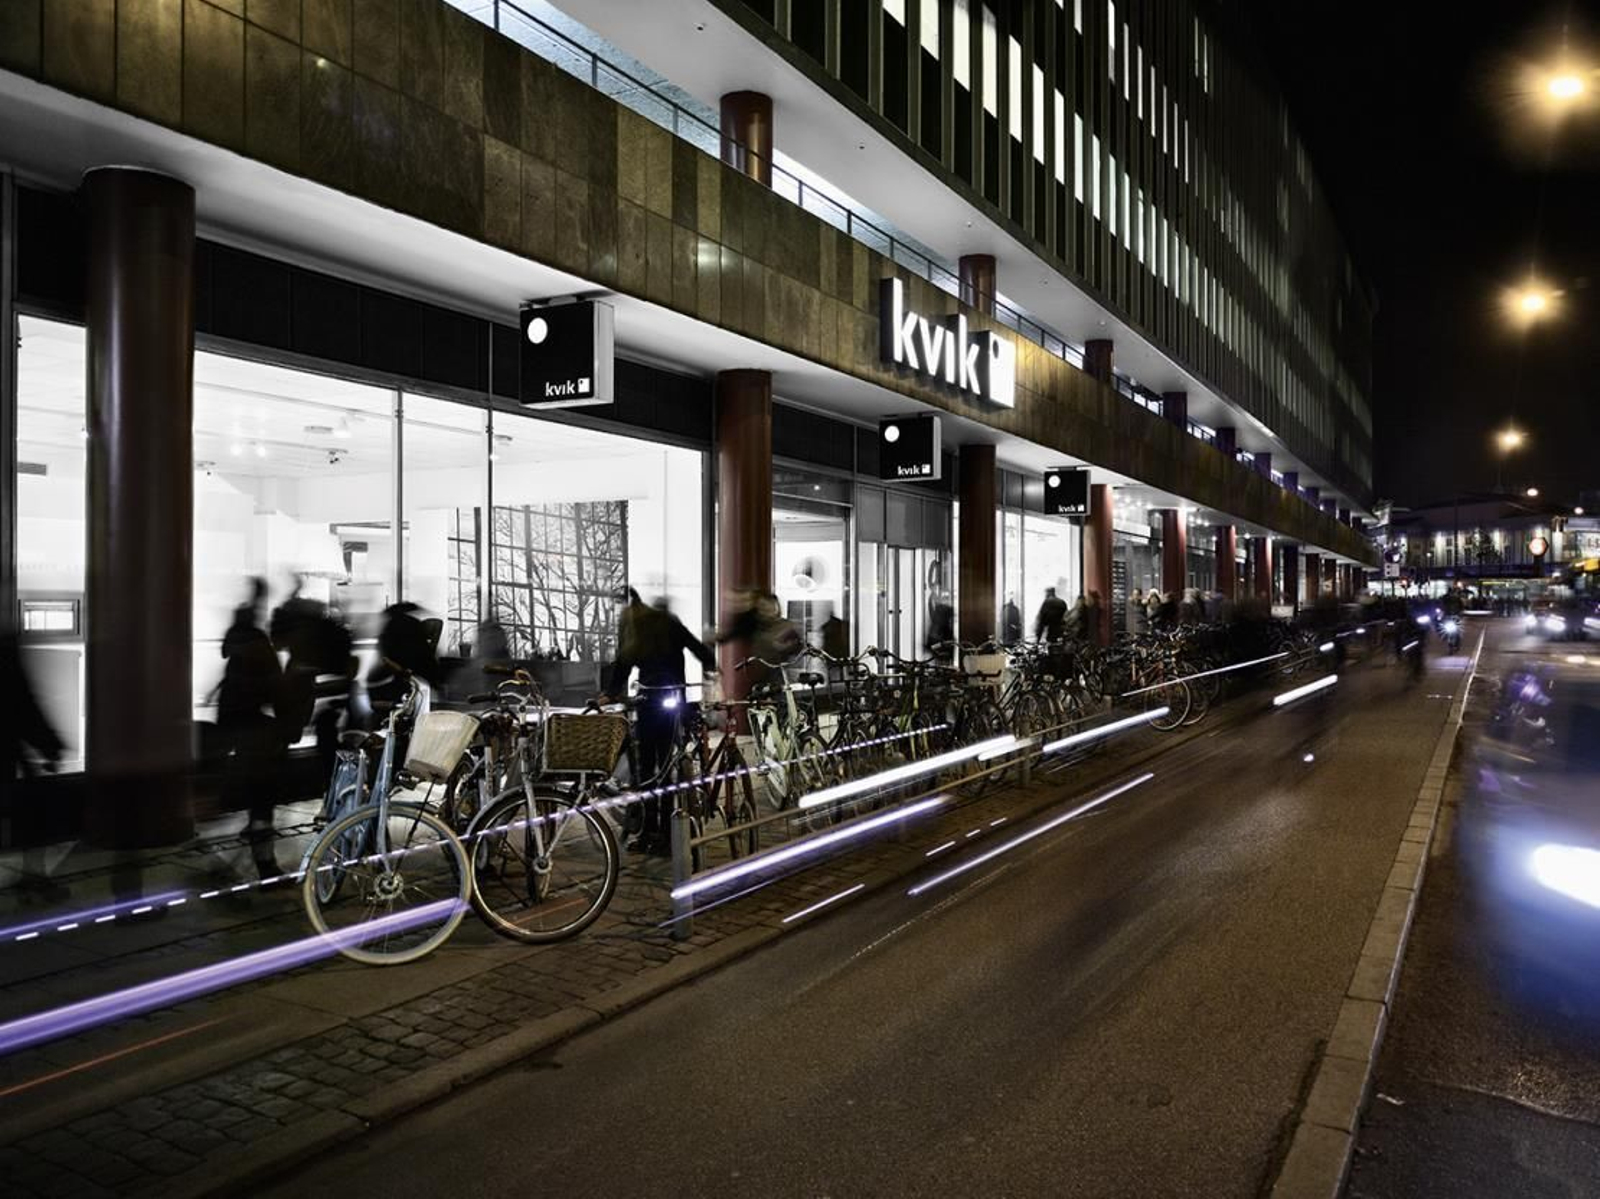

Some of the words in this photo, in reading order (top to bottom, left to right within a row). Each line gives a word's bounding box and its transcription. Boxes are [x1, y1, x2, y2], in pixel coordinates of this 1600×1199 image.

[893, 276, 981, 396] kvik
[545, 380, 575, 397] kvik
[897, 464, 921, 476] kvik
